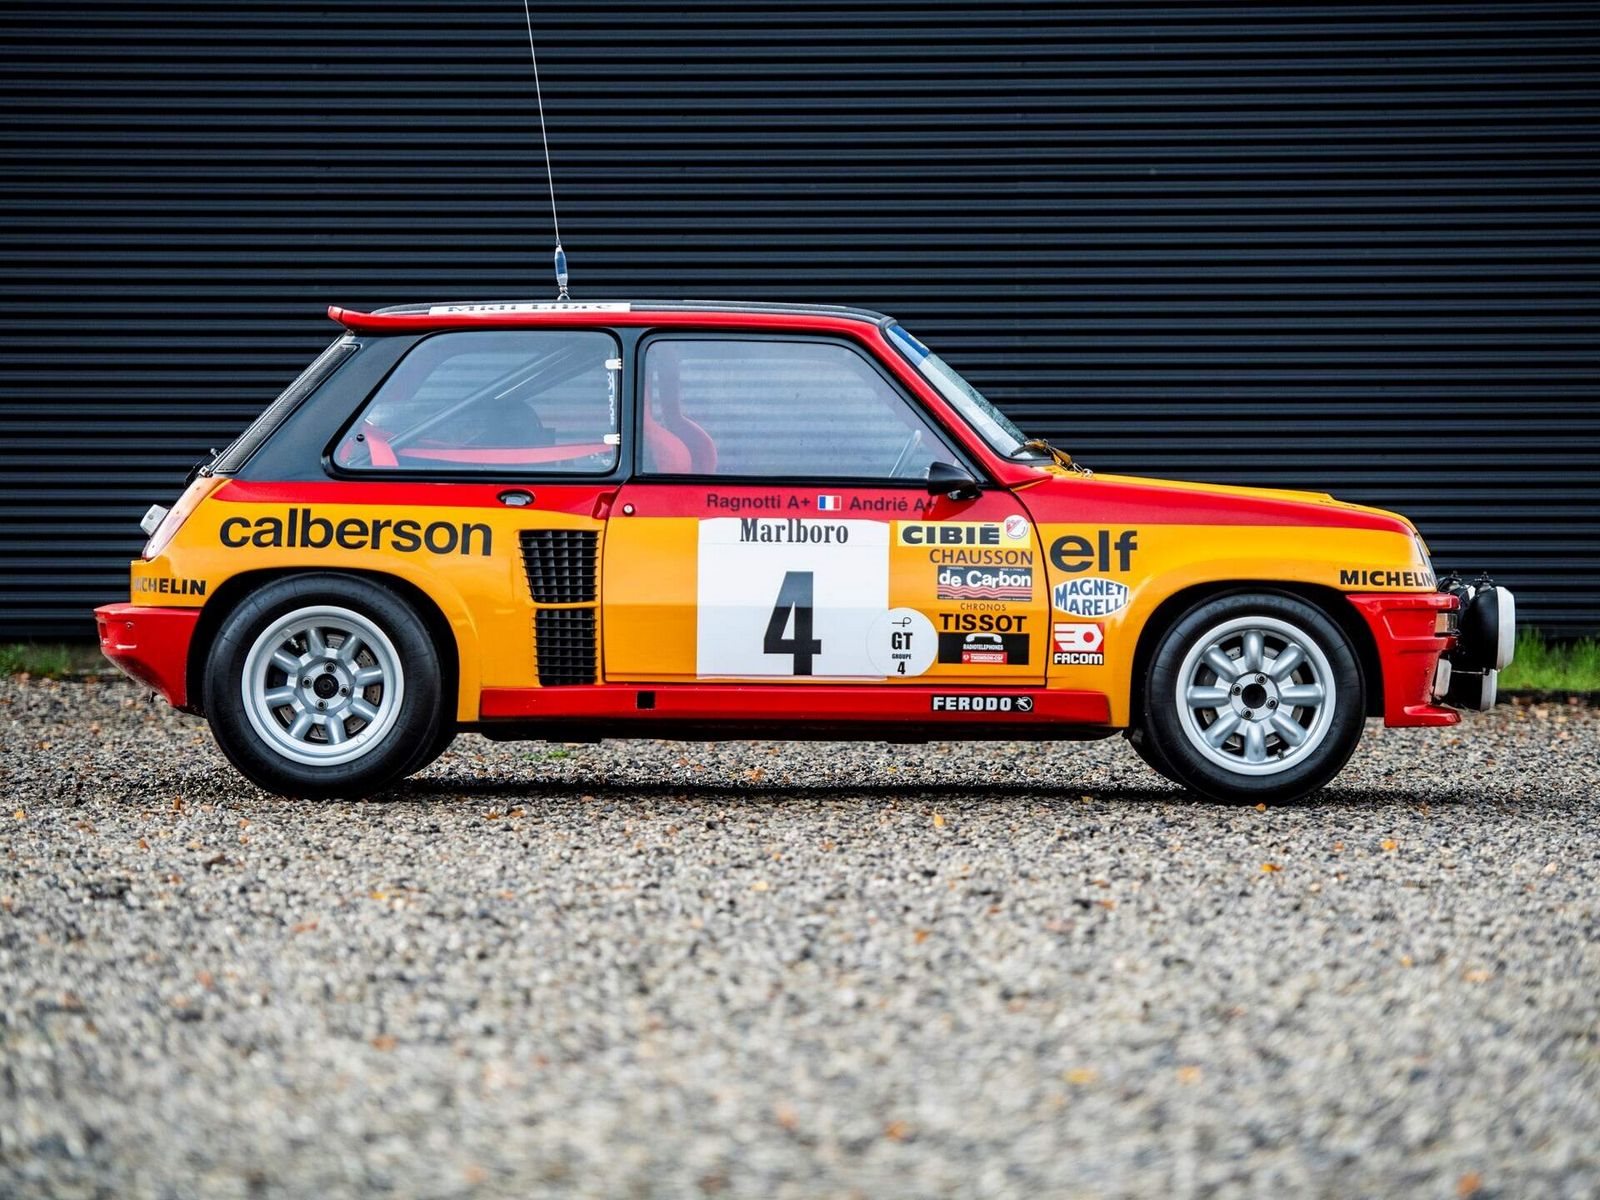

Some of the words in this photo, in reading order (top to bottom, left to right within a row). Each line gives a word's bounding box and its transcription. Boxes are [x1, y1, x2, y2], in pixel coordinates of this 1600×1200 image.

[706, 494, 781, 511] Ragnotti
[787, 495, 811, 508] A+
[849, 495, 908, 511] Andrié
[219, 508, 493, 556] calberson
[740, 518, 849, 544] Marlboro
[902, 524, 1000, 545] CIBIÉ
[929, 548, 1033, 565] CHAUSSON
[1049, 530, 1138, 573] elf
[939, 570, 962, 587] de
[966, 570, 1031, 588] Carbon
[1340, 569, 1435, 587] MICHELIN
[1055, 579, 1128, 600] MAGNETI
[960, 602, 1007, 611] CHRONOS
[763, 571, 822, 676] 4
[939, 613, 1028, 632] TISSOT
[891, 632, 913, 650] GT
[1054, 653, 1103, 664] FACOM
[897, 661, 906, 675] 4
[933, 697, 1012, 711] FERODO
